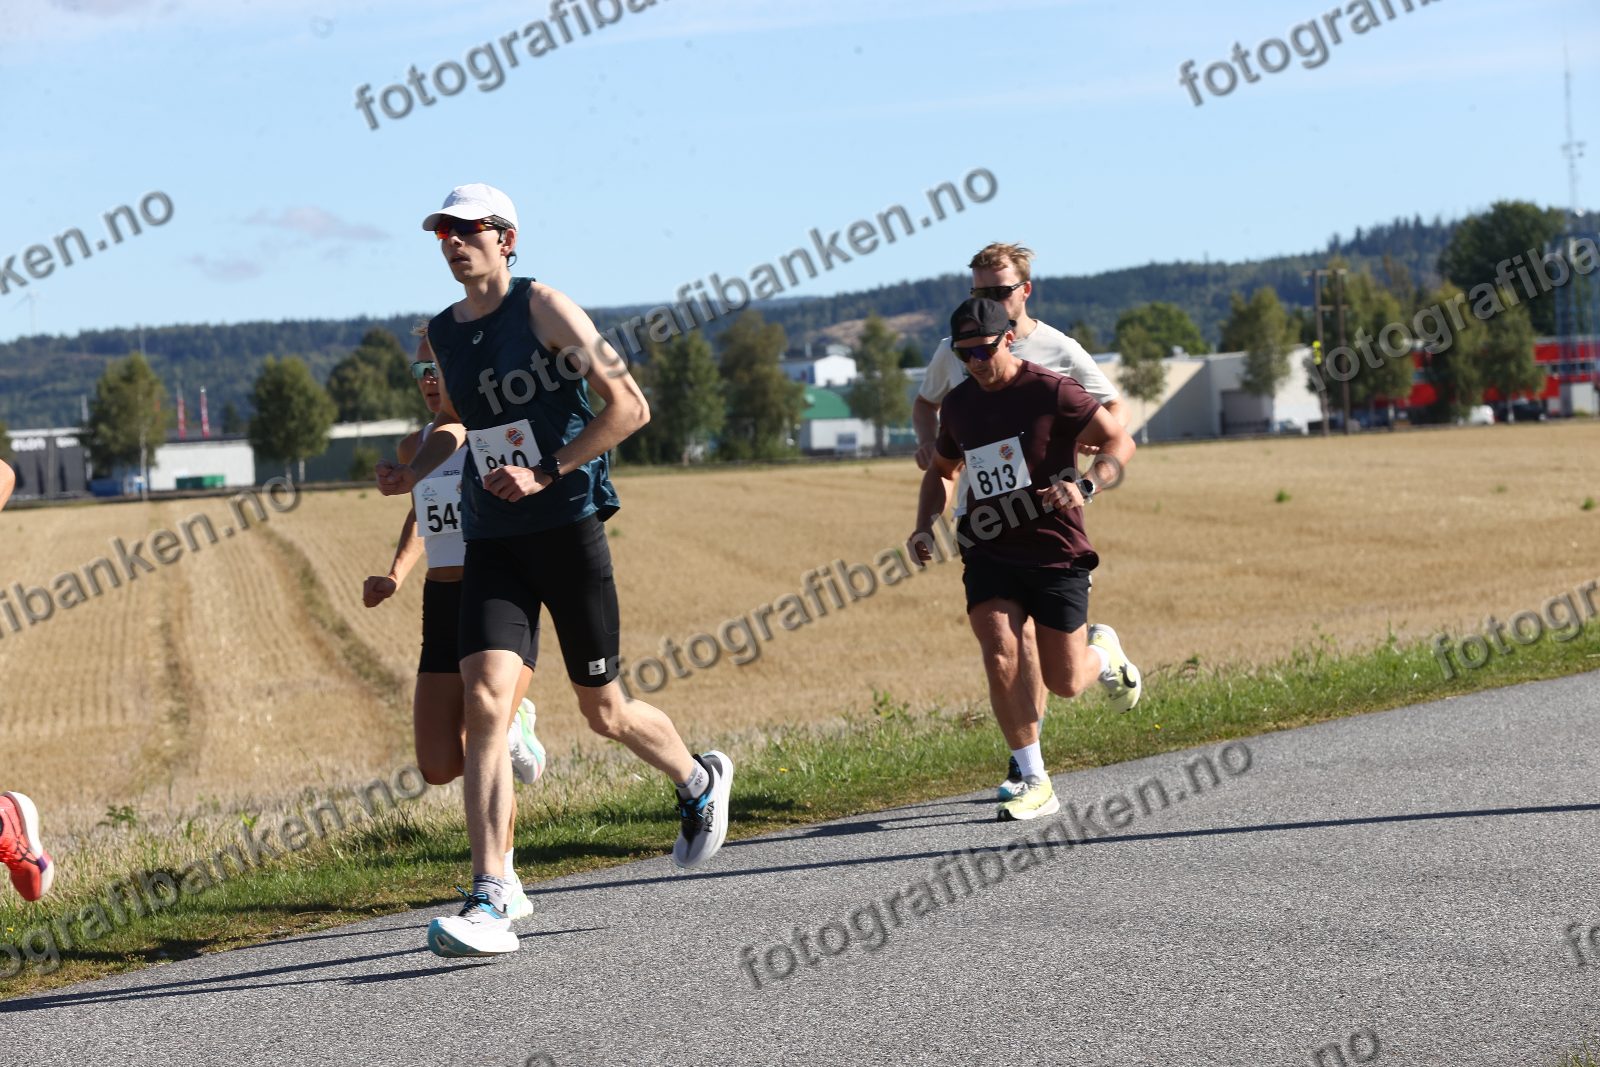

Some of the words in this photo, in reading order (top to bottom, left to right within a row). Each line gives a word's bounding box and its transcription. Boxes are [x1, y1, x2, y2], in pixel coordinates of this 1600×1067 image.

[977, 464, 1017, 495] 813
[427, 501, 462, 533] 54
[703, 801, 715, 833] HOKA
